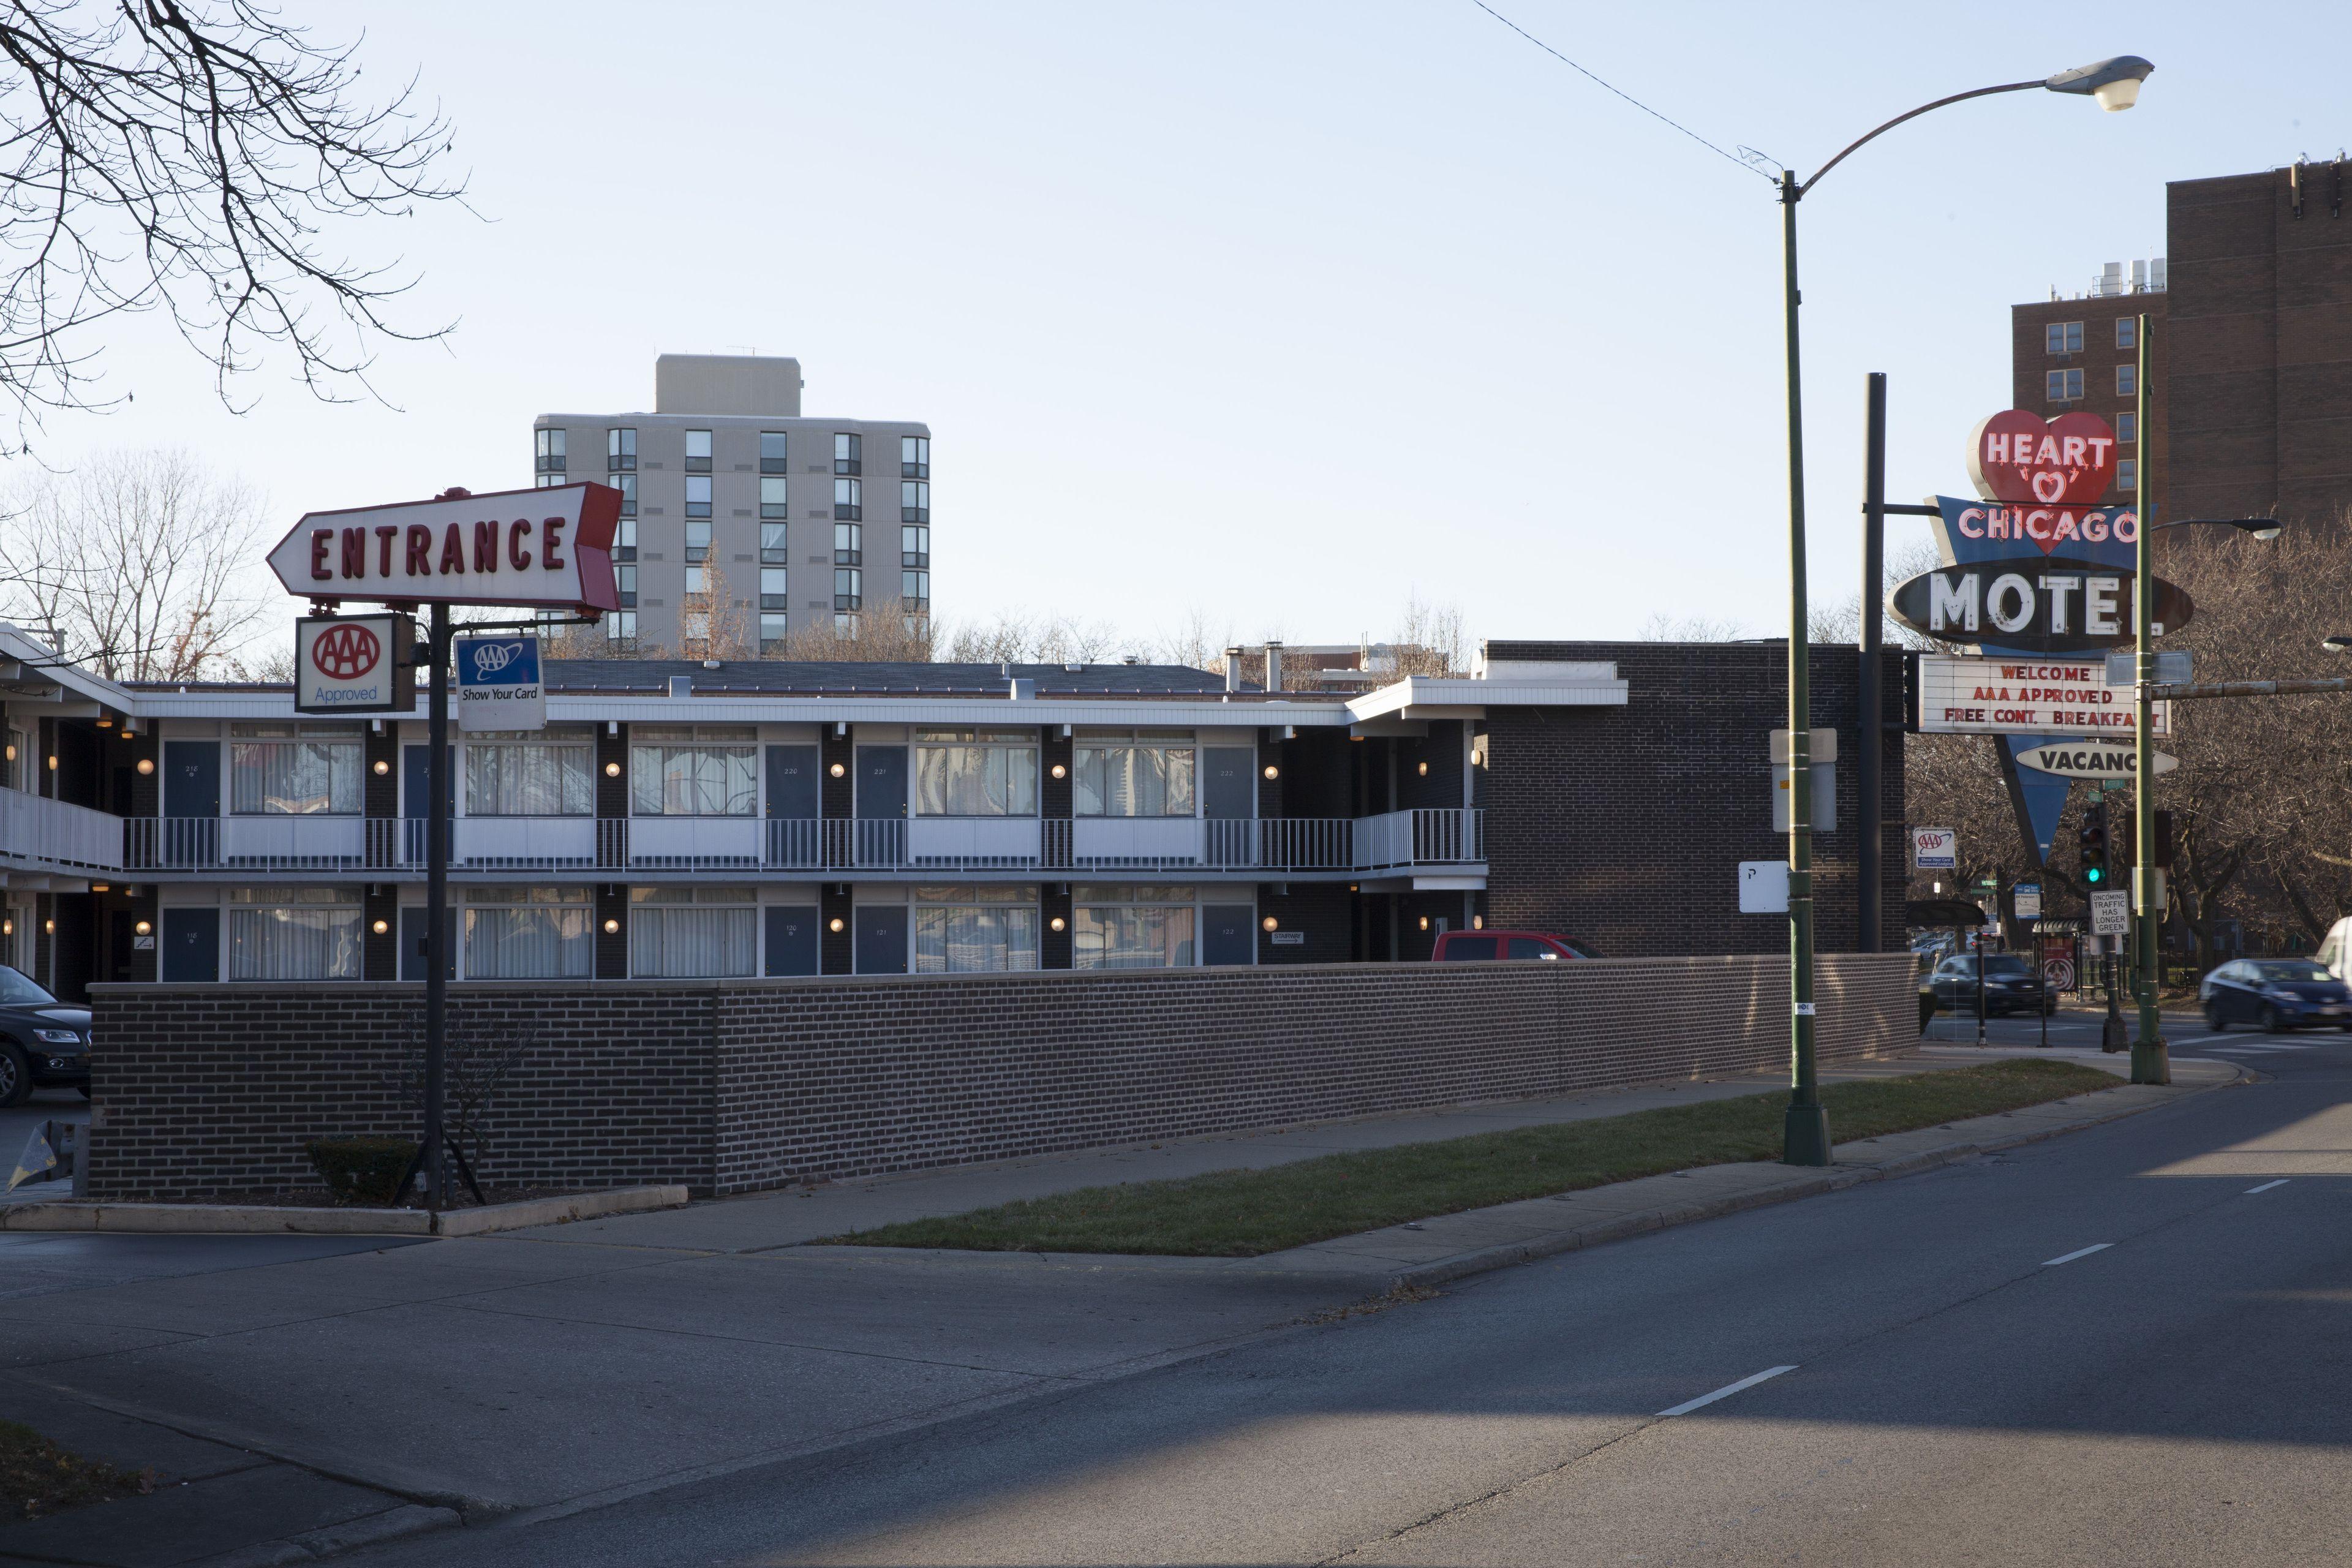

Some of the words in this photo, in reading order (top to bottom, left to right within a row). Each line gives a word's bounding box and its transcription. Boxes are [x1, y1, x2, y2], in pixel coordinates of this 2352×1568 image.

[1987, 432, 2113, 468] HEART
[1958, 508, 2138, 543] CHICAGO
[311, 516, 565, 581] ENTRANCE
[316, 625, 376, 678] AAA
[477, 645, 507, 671] AAA
[2001, 665, 2090, 681] WELCOME
[315, 685, 377, 704] Approved
[462, 688, 489, 700] Show
[492, 688, 513, 699] Your
[515, 687, 538, 699] Card
[1973, 687, 2010, 701] AAA
[2018, 688, 2113, 704] APPROVED
[1945, 708, 1985, 722] FREE
[1994, 709, 2037, 724] CONT.
[2054, 710, 2159, 727] BREAKFAT
[2039, 751, 2155, 772] VACANC
[1920, 834, 1940, 849] AAA
